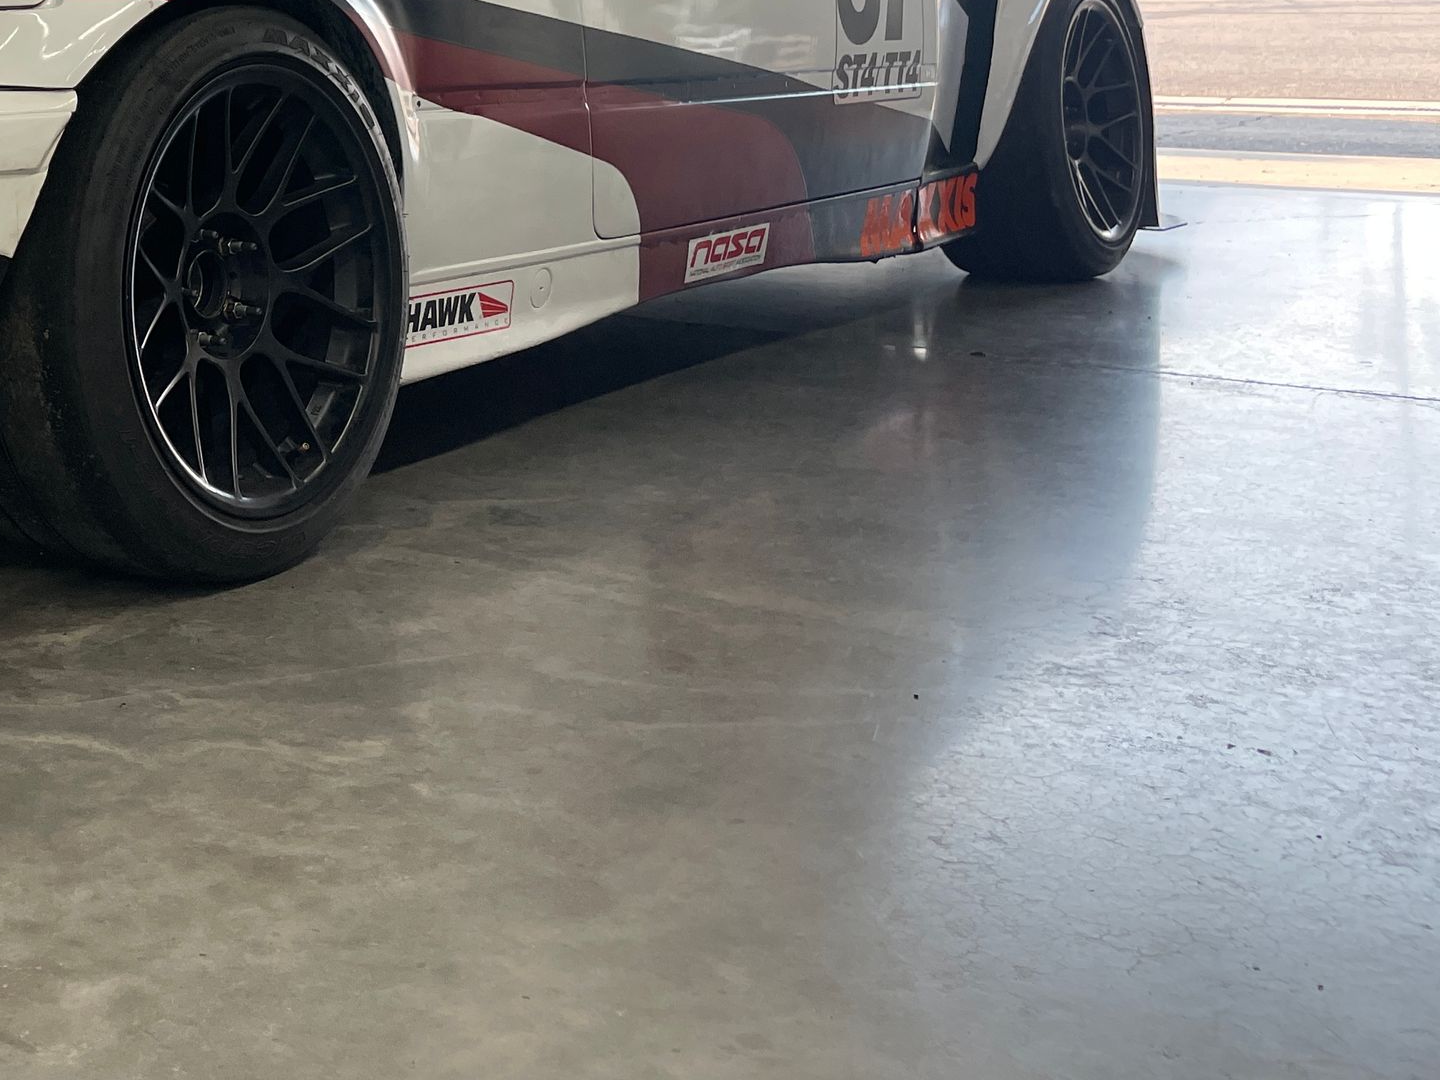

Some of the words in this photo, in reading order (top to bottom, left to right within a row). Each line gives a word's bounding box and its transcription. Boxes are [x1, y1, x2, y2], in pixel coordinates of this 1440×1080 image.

[833, 50, 921, 99] ST4/TT4
[861, 172, 978, 257] MAXXIS
[407, 292, 477, 334] HAWK
[407, 317, 509, 343] ERFORMANCE
